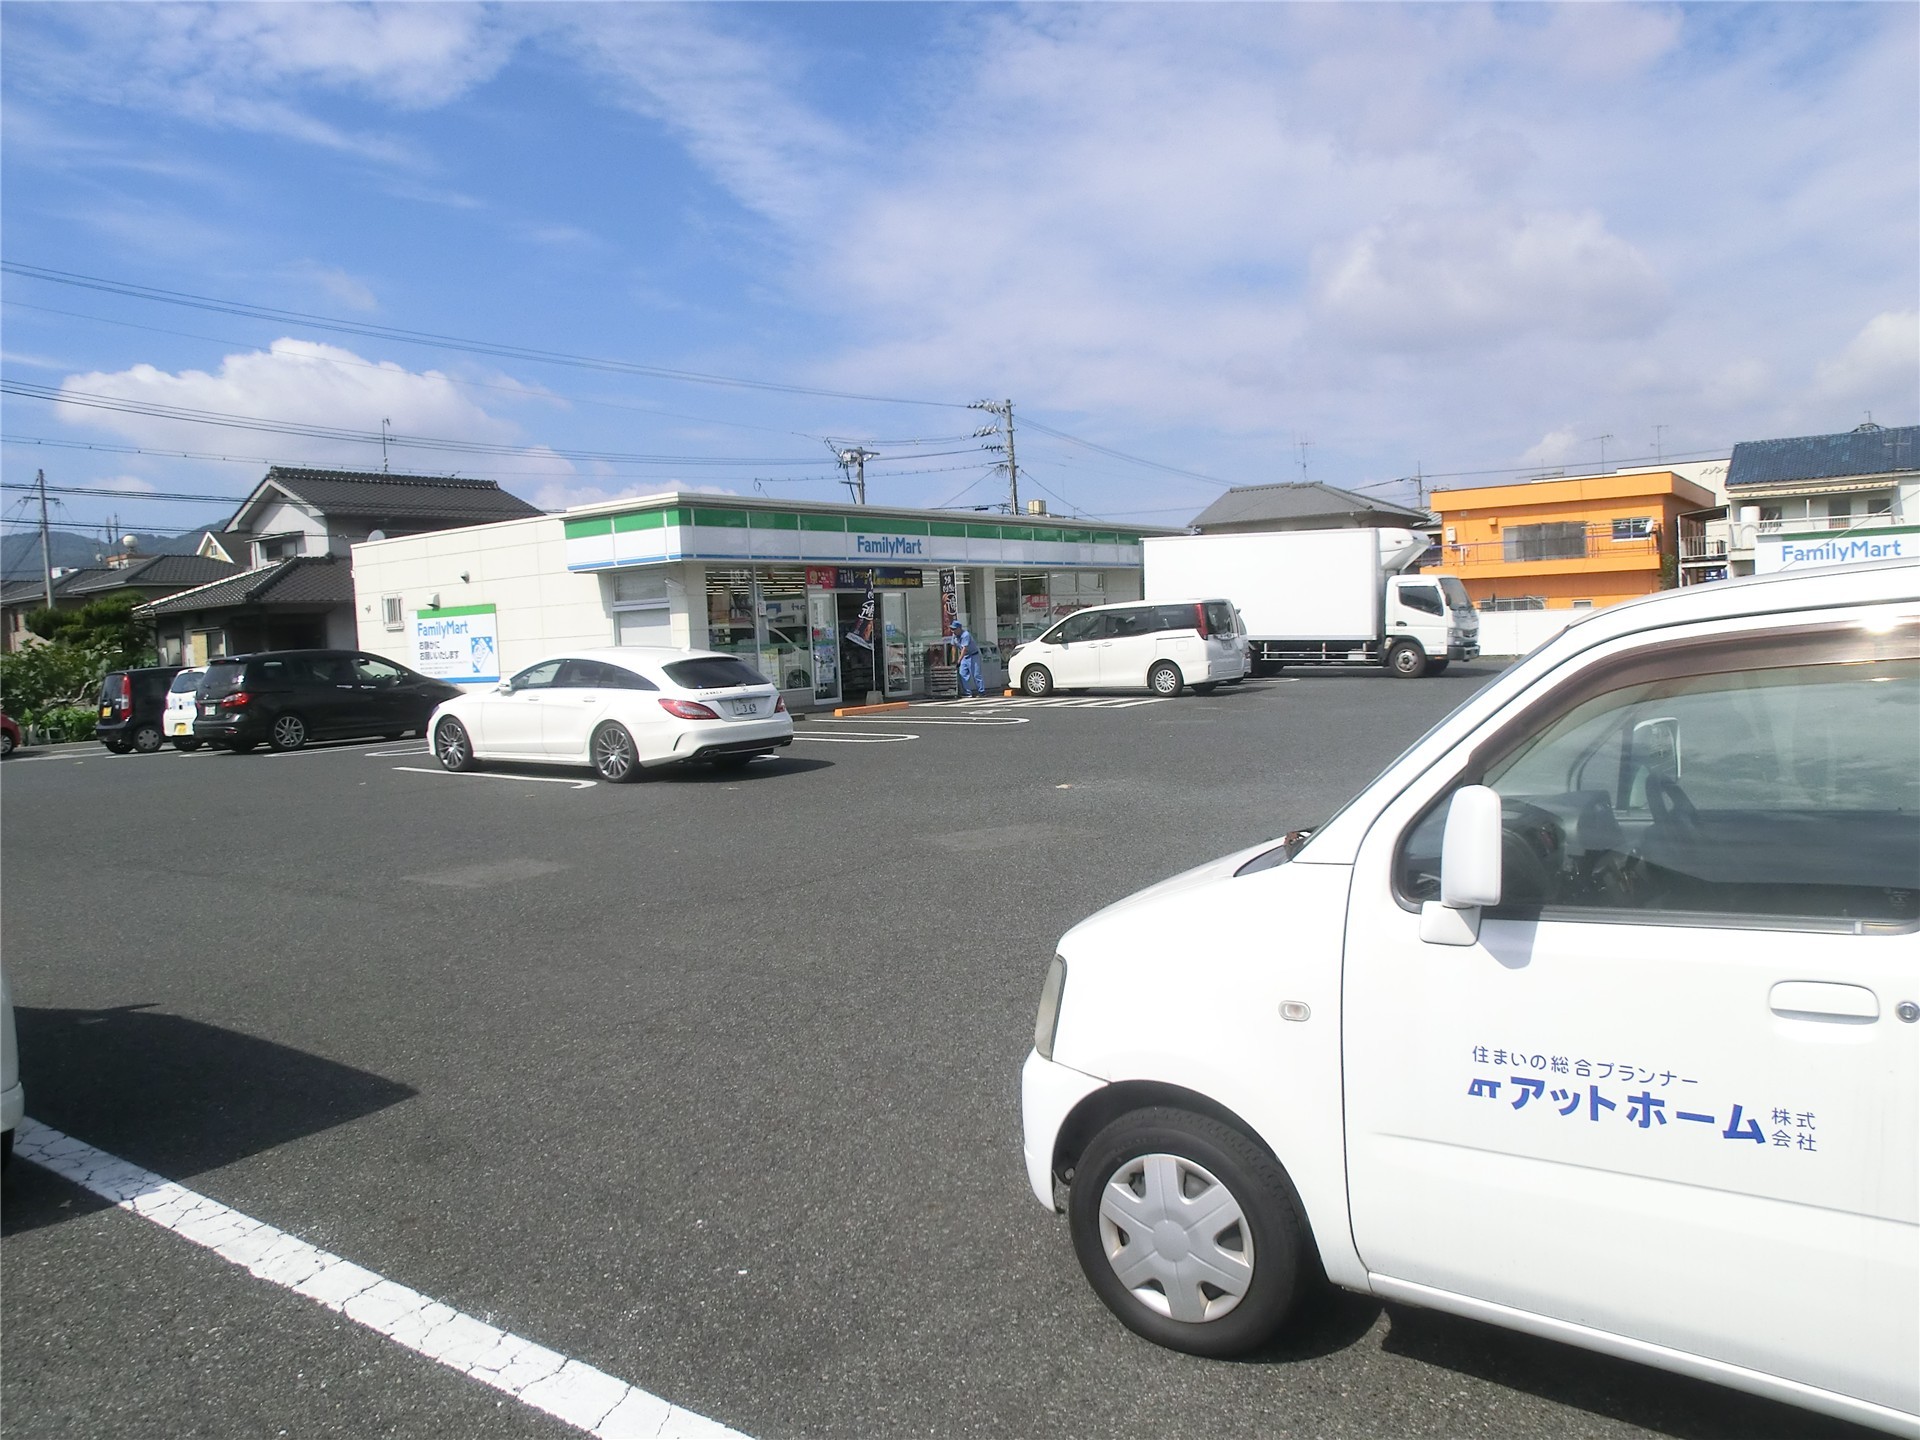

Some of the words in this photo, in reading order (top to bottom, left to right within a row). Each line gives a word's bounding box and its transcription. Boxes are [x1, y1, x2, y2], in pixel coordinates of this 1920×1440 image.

[857, 535, 922, 558] FamilyMart
[1782, 540, 1901, 562] FamilyMart
[417, 620, 469, 639] FamilyMart
[1472, 1045, 1698, 1087] 住まいの総合プランナー
[1510, 1076, 1766, 1144] アットホーム
